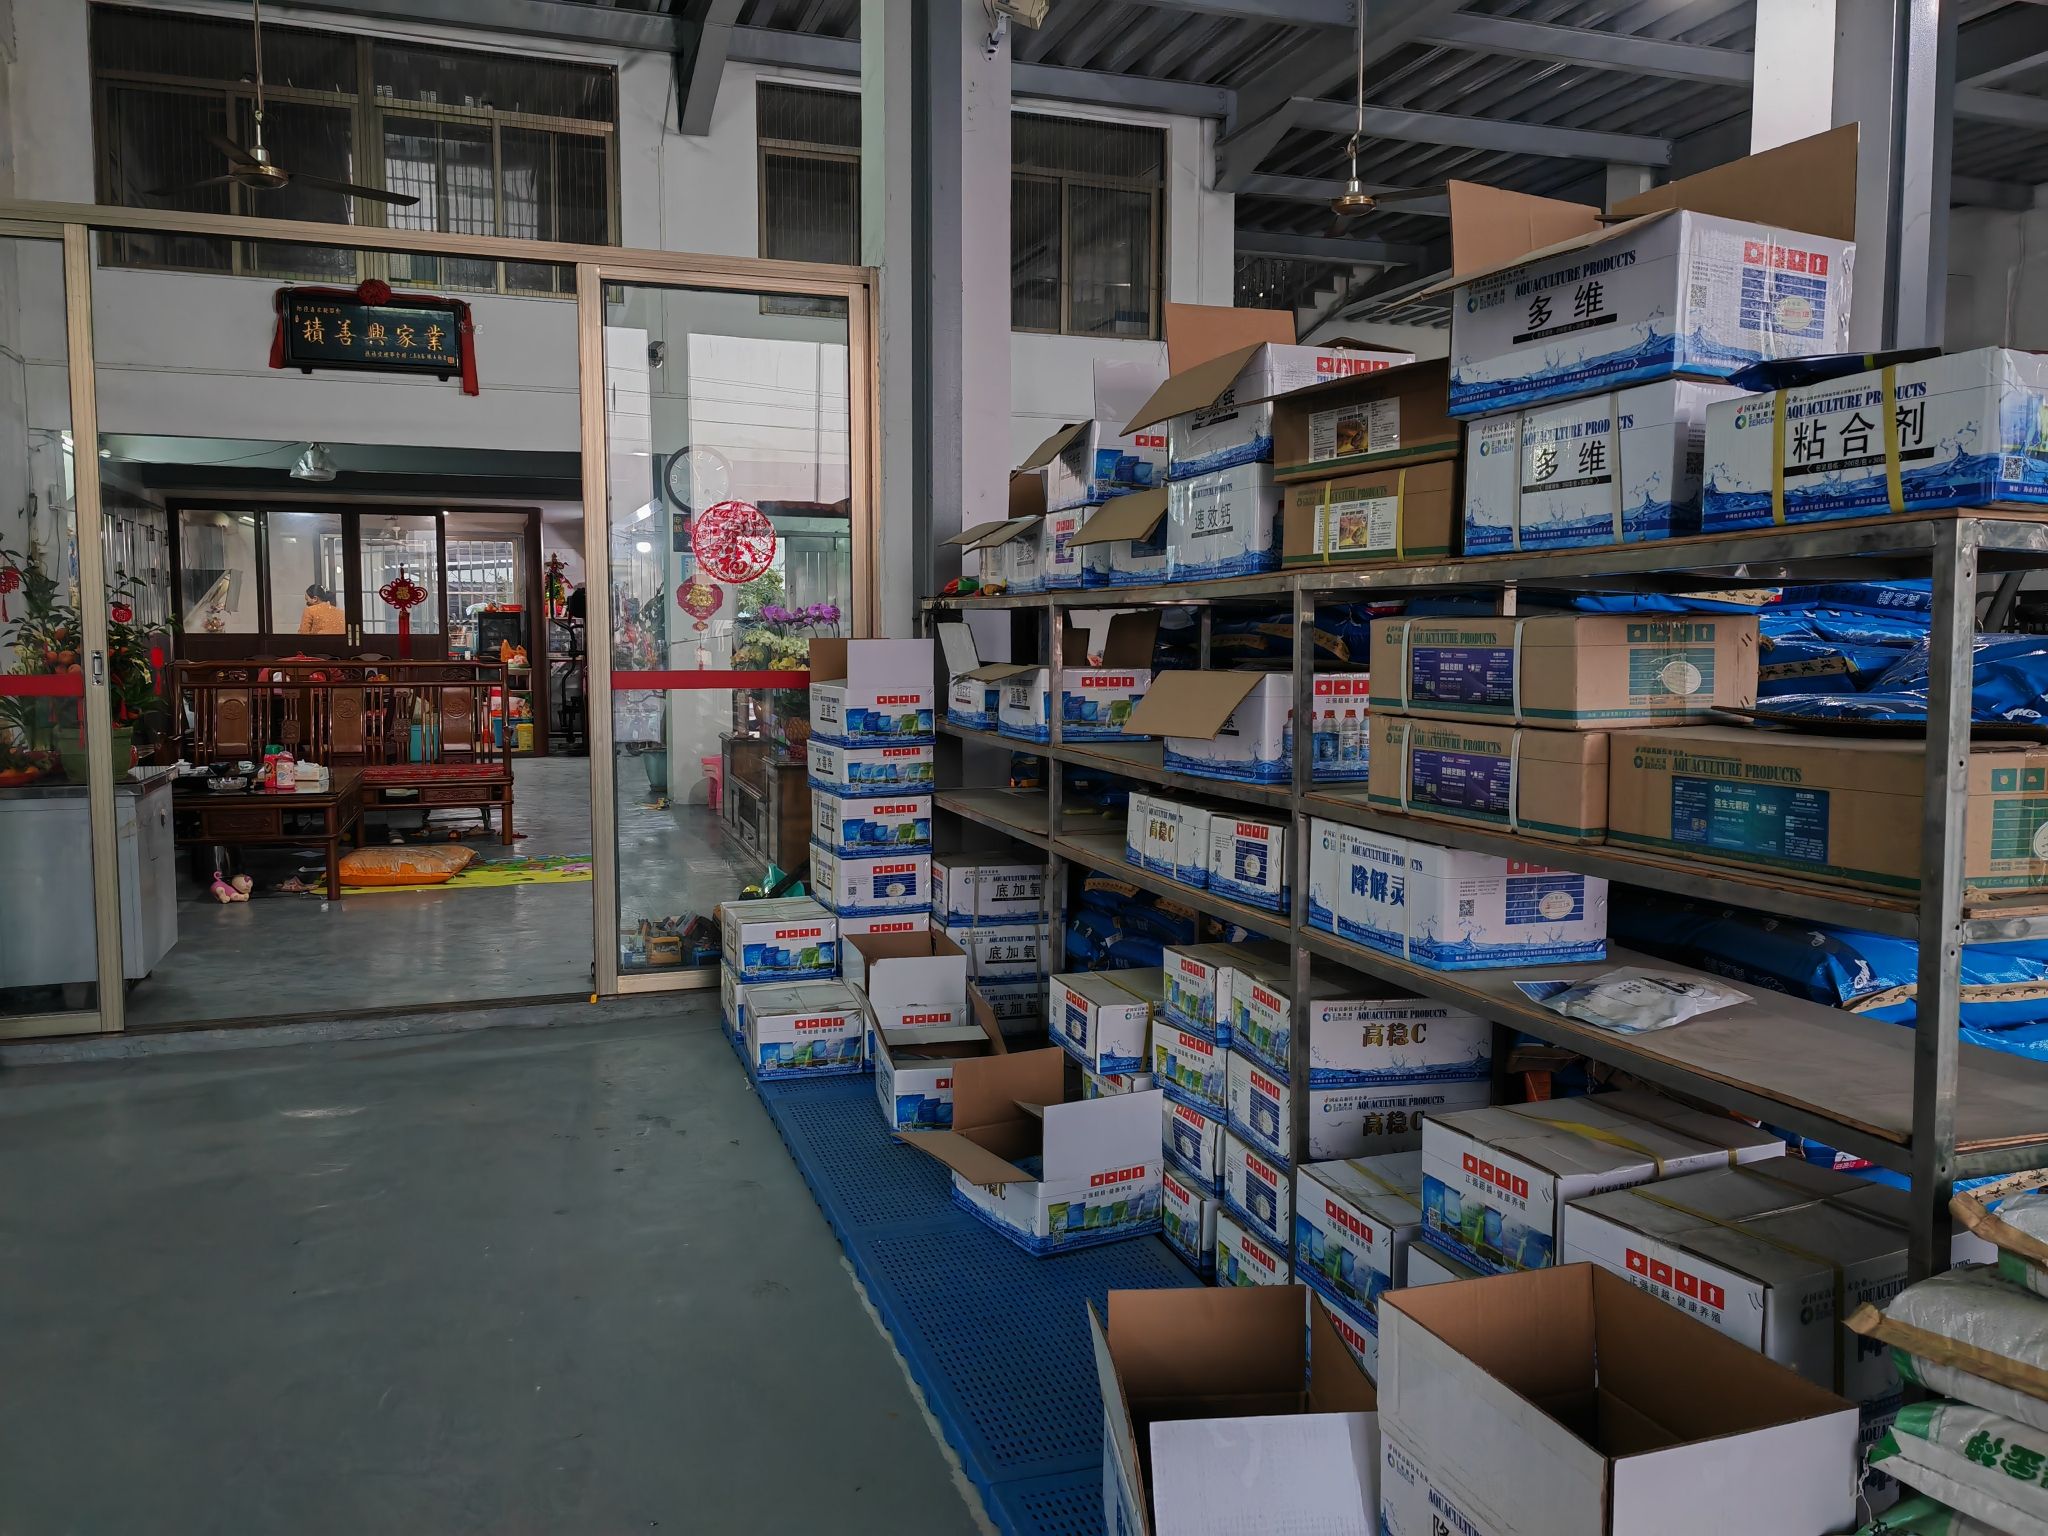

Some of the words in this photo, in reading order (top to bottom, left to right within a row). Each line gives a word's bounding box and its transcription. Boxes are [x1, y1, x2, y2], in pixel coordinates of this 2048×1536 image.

[1516, 266, 1581, 297] AQUACULTURE
[1583, 250, 1636, 278] PRODUCTS
[1528, 281, 1604, 331] 多维
[1786, 394, 1862, 420] AQUACULTURE
[1585, 414, 1634, 436] PRODCTS
[1792, 401, 1926, 463] 粘合剂
[1536, 439, 1606, 482] 多维
[1195, 503, 1231, 531] 速效钙
[1672, 756, 1743, 778] AQUACULTURE
[1745, 763, 1802, 783] PRODUCTS
[1351, 843, 1391, 864] AQUACULTURE
[995, 882, 1041, 897] 底加氧
[1351, 863, 1405, 908] 降解灵
[988, 945, 1036, 960] 底加氧
[993, 1001, 1040, 1016] 底加氧
[1356, 1009, 1409, 1021] AQUACULTURE
[1410, 1008, 1448, 1019] PRODUCTS
[1362, 1022, 1428, 1047] 高稳C
[1356, 1098, 1408, 1110] AQUACULTURE
[1408, 1095, 1446, 1106] PRODUCTS
[1362, 1110, 1426, 1137] 高稳C
[1465, 1173, 1527, 1212] 正强超越·健康养殖
[1629, 1275, 1722, 1324] 正强超越·健康养殖
